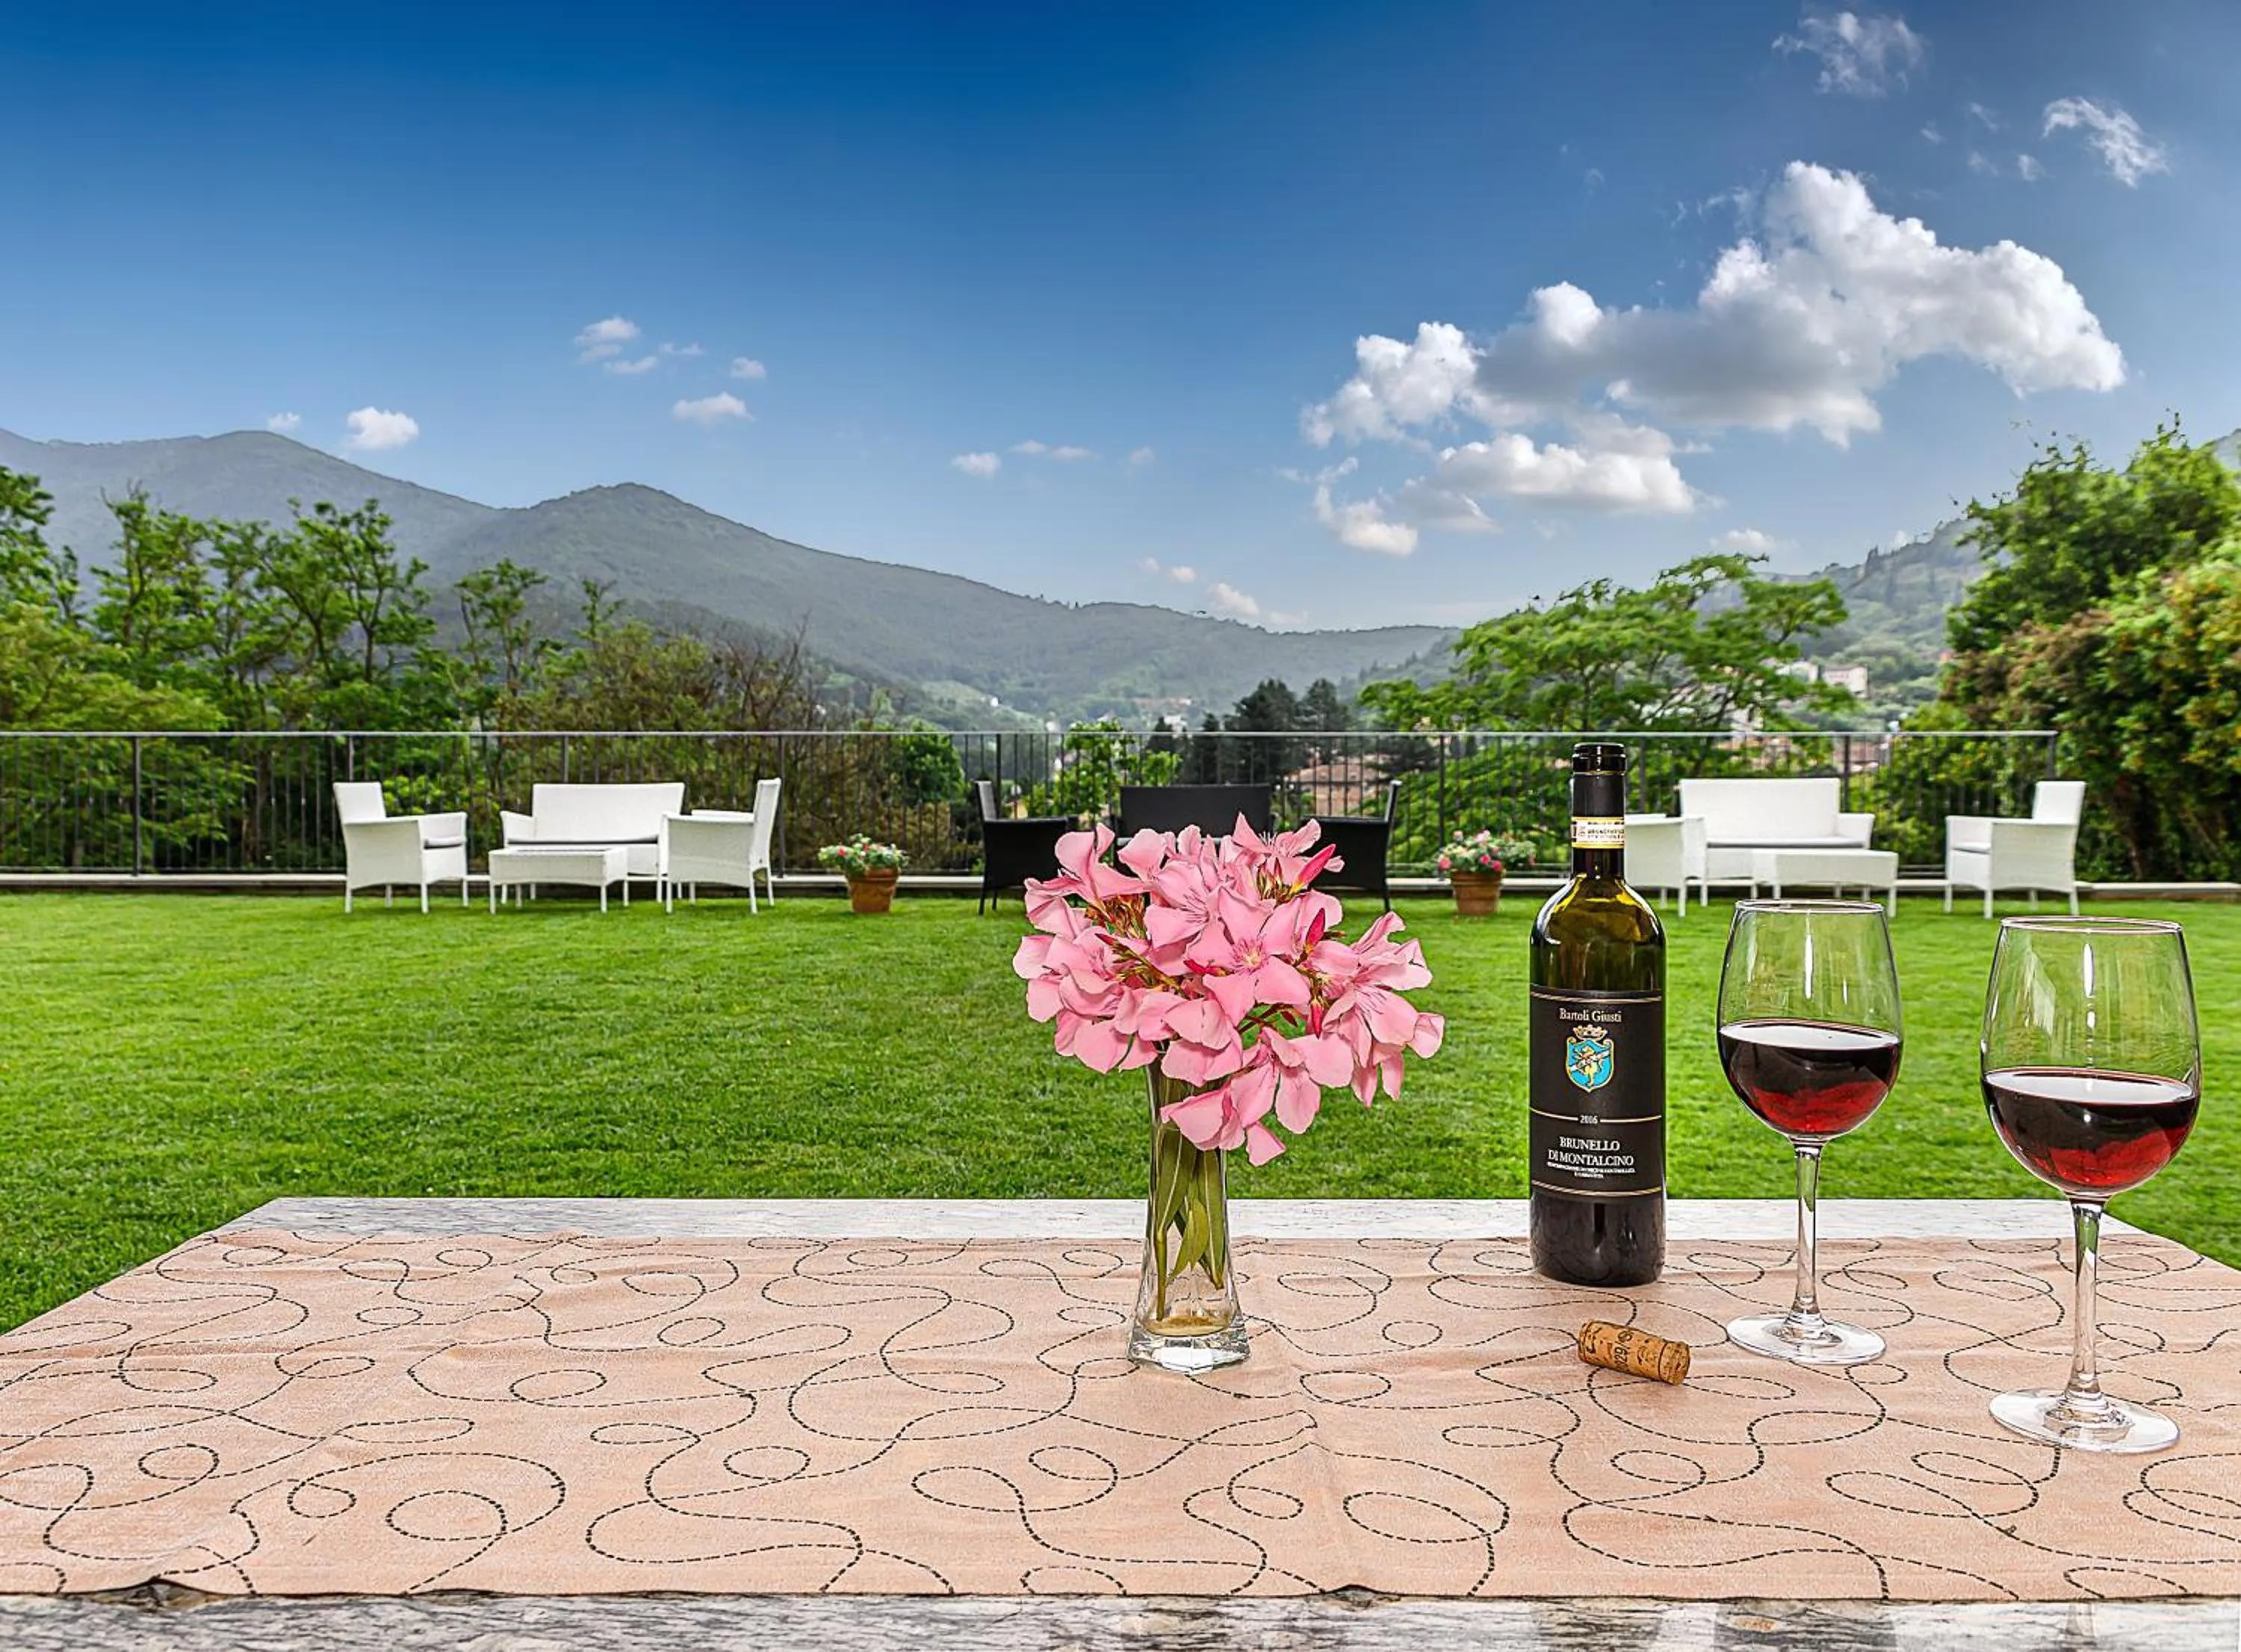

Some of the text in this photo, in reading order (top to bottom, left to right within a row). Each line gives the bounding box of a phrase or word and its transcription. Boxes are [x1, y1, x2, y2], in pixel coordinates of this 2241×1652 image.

[1559, 1007, 1622, 1022] Bartoli Giusti
[1559, 1136, 1620, 1151] BRUNELLO
[1548, 1149, 1634, 1167] DI MONTALCINO
